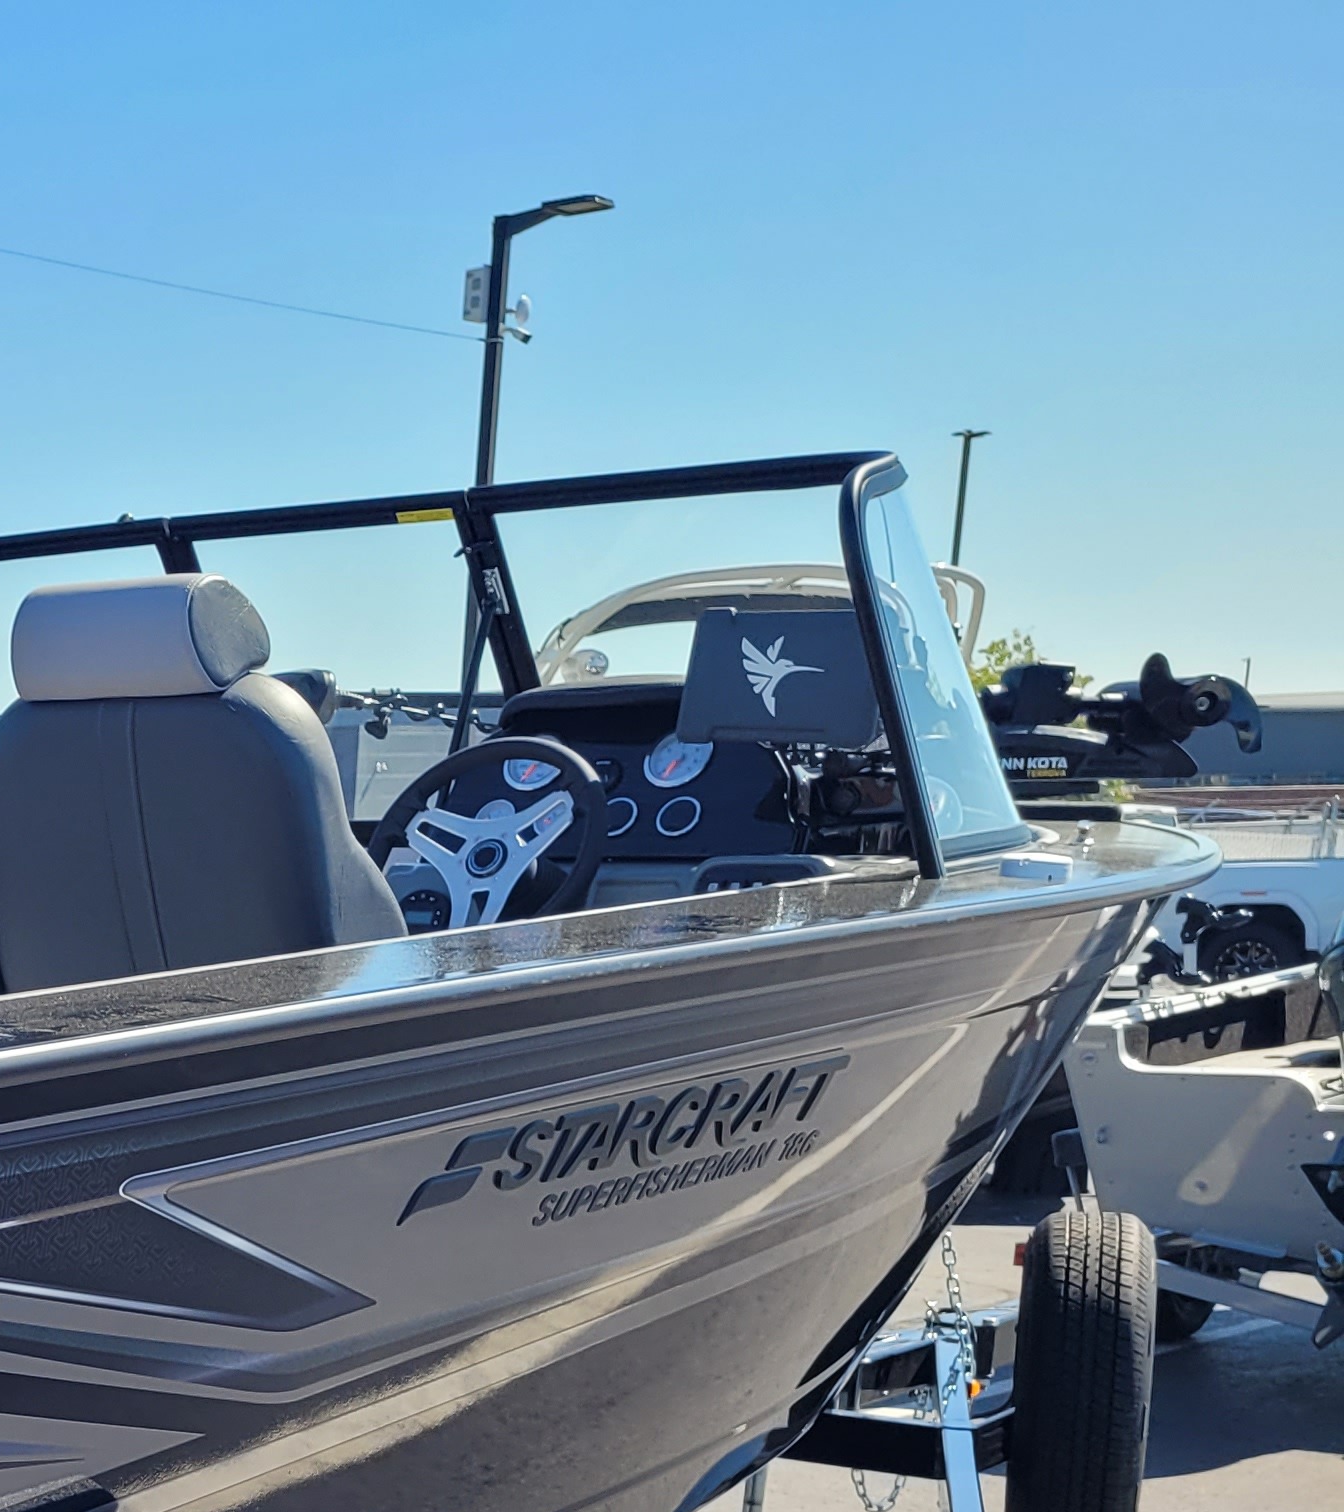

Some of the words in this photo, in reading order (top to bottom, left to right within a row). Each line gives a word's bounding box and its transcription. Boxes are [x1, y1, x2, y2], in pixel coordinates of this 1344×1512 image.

[1026, 755, 1068, 770] KOTA
[492, 1054, 851, 1191] STARCRAFT
[531, 1138, 778, 1227] SUPERFISHERMAN
[777, 1129, 820, 1162] 186
